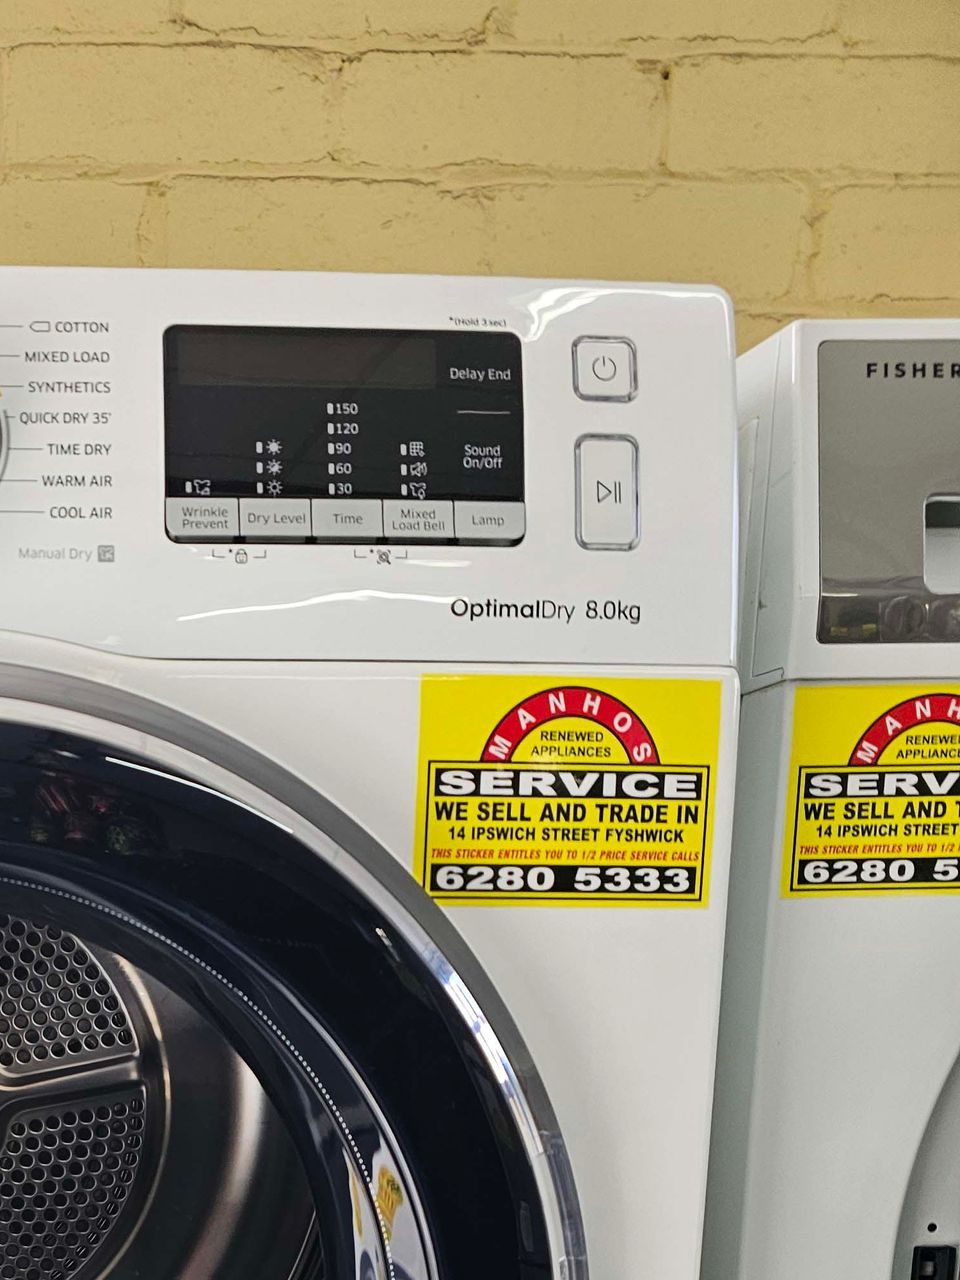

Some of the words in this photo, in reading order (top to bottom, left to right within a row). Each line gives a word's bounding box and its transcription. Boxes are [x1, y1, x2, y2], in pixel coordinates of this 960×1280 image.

[55, 321, 109, 333] COTTON
[25, 351, 69, 363] MIXED
[73, 351, 110, 363] LOAD
[450, 367, 485, 382] Delay
[488, 368, 511, 381] End
[866, 362, 960, 378] FISHER
[28, 381, 111, 393] SYNTHETICS
[336, 402, 359, 415] 150
[19, 412, 59, 425] QUICK
[63, 412, 89, 424] DRY
[336, 423, 359, 435] 120
[47, 443, 81, 456] TIME
[84, 443, 112, 456] DRY
[335, 442, 352, 455] 90
[464, 444, 501, 457] Sound
[336, 462, 352, 475] 60
[462, 456, 503, 470] On/Off
[41, 475, 86, 487] WARM
[89, 475, 113, 487] AIR
[336, 483, 353, 495] 30
[49, 507, 86, 519] COOL
[90, 507, 113, 519] AIR
[182, 506, 228, 518] Wrinkle
[247, 513, 270, 525] Dry
[273, 512, 306, 524] Level
[401, 509, 436, 520] Mixed
[182, 519, 228, 529] Prevent
[333, 513, 363, 525] Time
[392, 520, 420, 531] Load
[424, 521, 445, 531] Bell
[472, 515, 505, 527] Lamp
[18, 548, 66, 560] Manual
[69, 548, 93, 562] Dry
[450, 598, 576, 624] OptimalDry
[585, 600, 641, 625] 8.0kg
[489, 691, 652, 762] MANHOS
[540, 730, 604, 743] RENEWED
[905, 734, 960, 745] RENEWE
[530, 745, 611, 758] APPLIANCES
[438, 770, 698, 799] SERVICE
[435, 801, 468, 822] WE
[477, 802, 531, 823] SELL
[540, 803, 586, 823] AND
[595, 804, 668, 824] TRADE
[677, 804, 699, 825] IN
[804, 802, 836, 820] WE
[843, 801, 895, 820] SELL
[902, 800, 947, 819] AND
[448, 826, 466, 841] 14
[471, 826, 536, 841] IPSWICH
[542, 827, 599, 842] STREET
[605, 828, 684, 843] FYSHWICK
[816, 824, 832, 838] 14
[837, 824, 898, 837] IPSWICH
[903, 823, 960, 837] STREET
[432, 848, 452, 859] THIS
[455, 848, 494, 859] STICKER
[498, 849, 541, 860] ENTITLES
[545, 849, 563, 860] YOU
[567, 849, 578, 860] TO
[582, 849, 597, 860] 1/2
[599, 850, 626, 861] PRICE
[630, 850, 668, 861] SERVICE
[671, 850, 700, 862] CALLS
[800, 845, 819, 855] THIS
[822, 844, 859, 854] STICKER
[861, 844, 902, 854] ENTITLES
[905, 843, 924, 854] YOU
[926, 843, 937, 853] TO
[940, 843, 955, 853] 1/2
[803, 859, 915, 884] 6280
[436, 865, 556, 892] 6280
[573, 867, 691, 893] 5333
